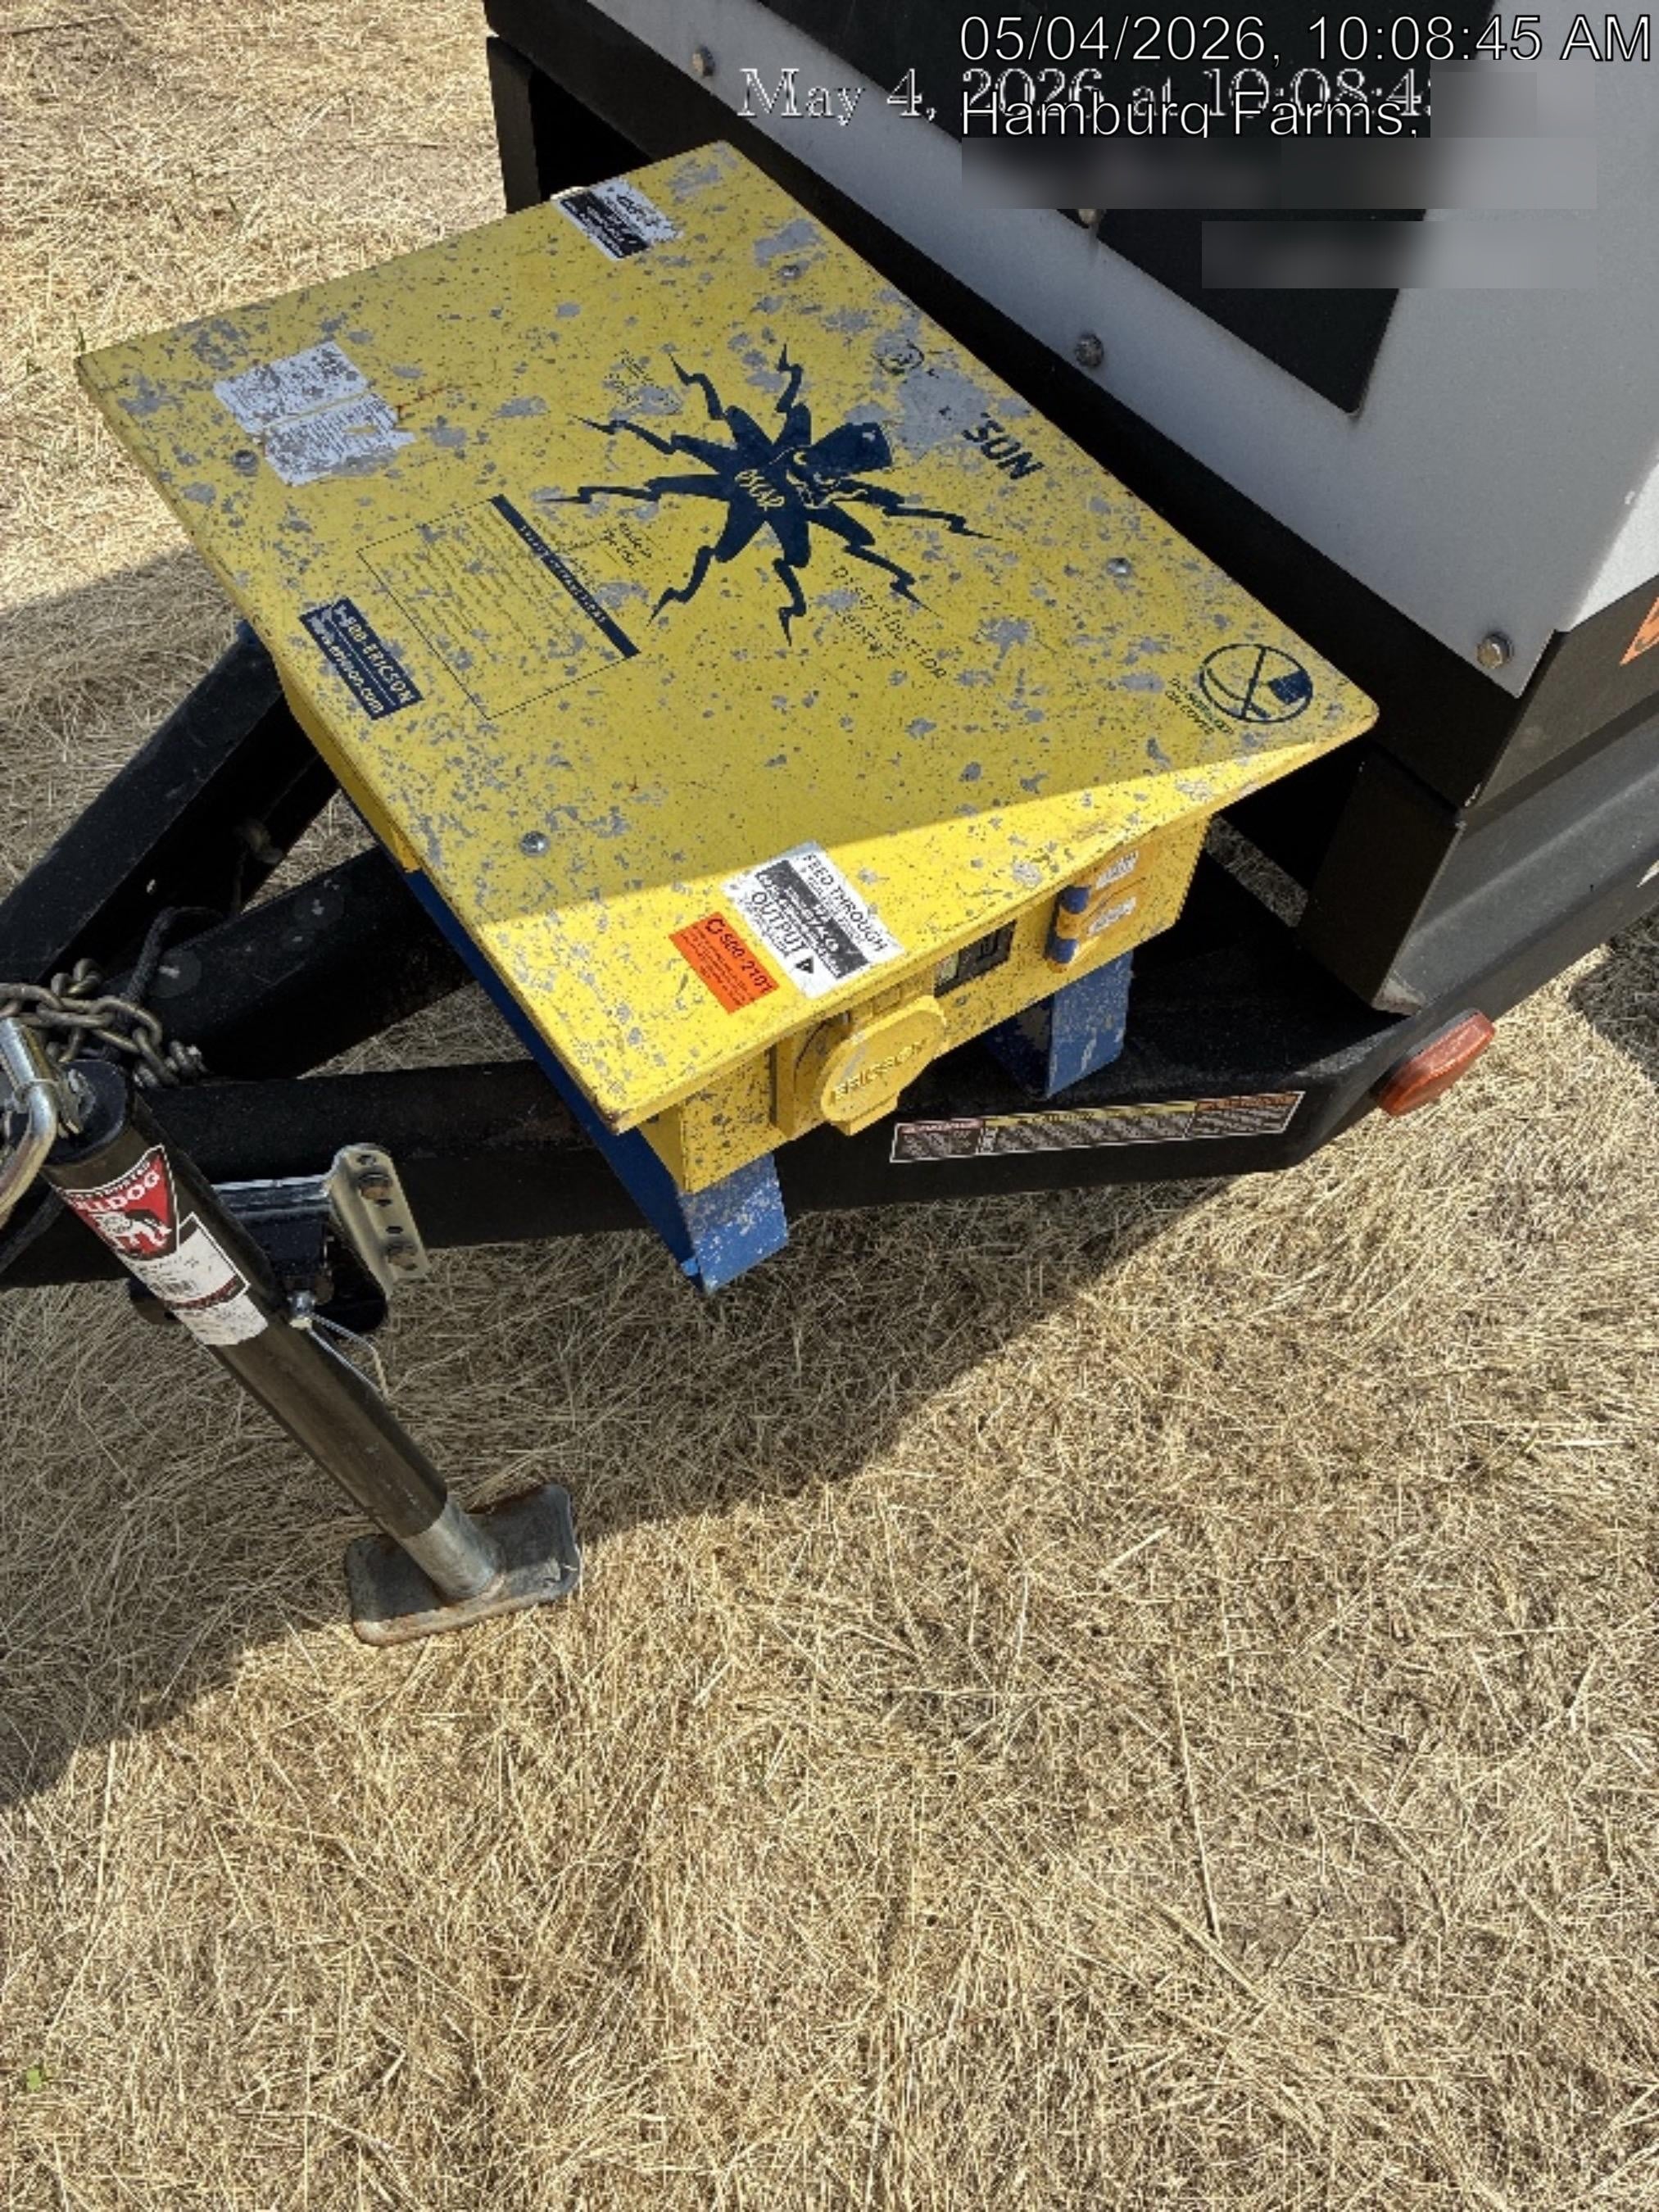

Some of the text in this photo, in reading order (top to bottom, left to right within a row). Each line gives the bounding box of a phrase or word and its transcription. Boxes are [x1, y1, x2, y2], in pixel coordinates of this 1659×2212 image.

[750, 890, 809, 954] OUTPUT
[802, 852, 836, 887] FEED
[829, 885, 890, 953] THROUGH
